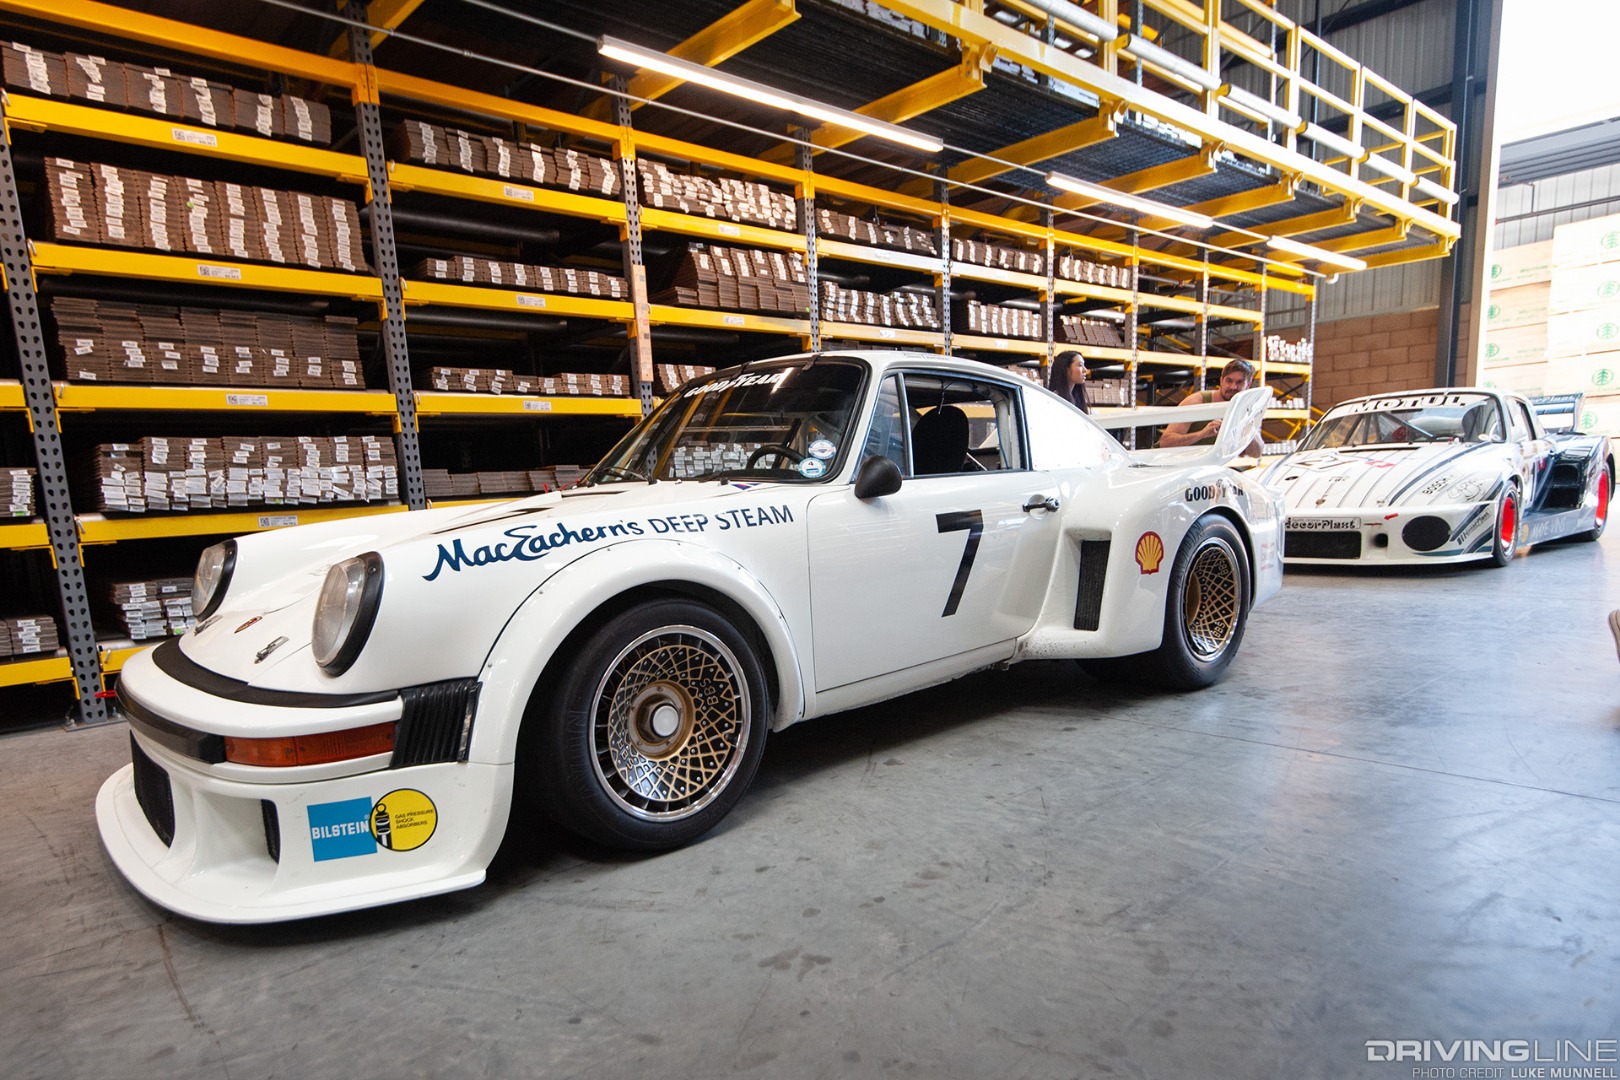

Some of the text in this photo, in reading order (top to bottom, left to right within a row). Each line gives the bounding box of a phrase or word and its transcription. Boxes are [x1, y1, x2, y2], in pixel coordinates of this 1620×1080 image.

[683, 372, 784, 398] GOODYEAR
[1349, 395, 1466, 413] MOTUL
[1185, 480, 1244, 502] GOODYAR
[647, 514, 709, 534] DEEP
[719, 504, 794, 530] STEAM
[935, 509, 984, 617] 7
[700, 677, 719, 706] BBS
[407, 809, 434, 817] PRESSURE
[312, 820, 370, 840] BILSTEIN
[396, 820, 428, 829] ABSORBERS
